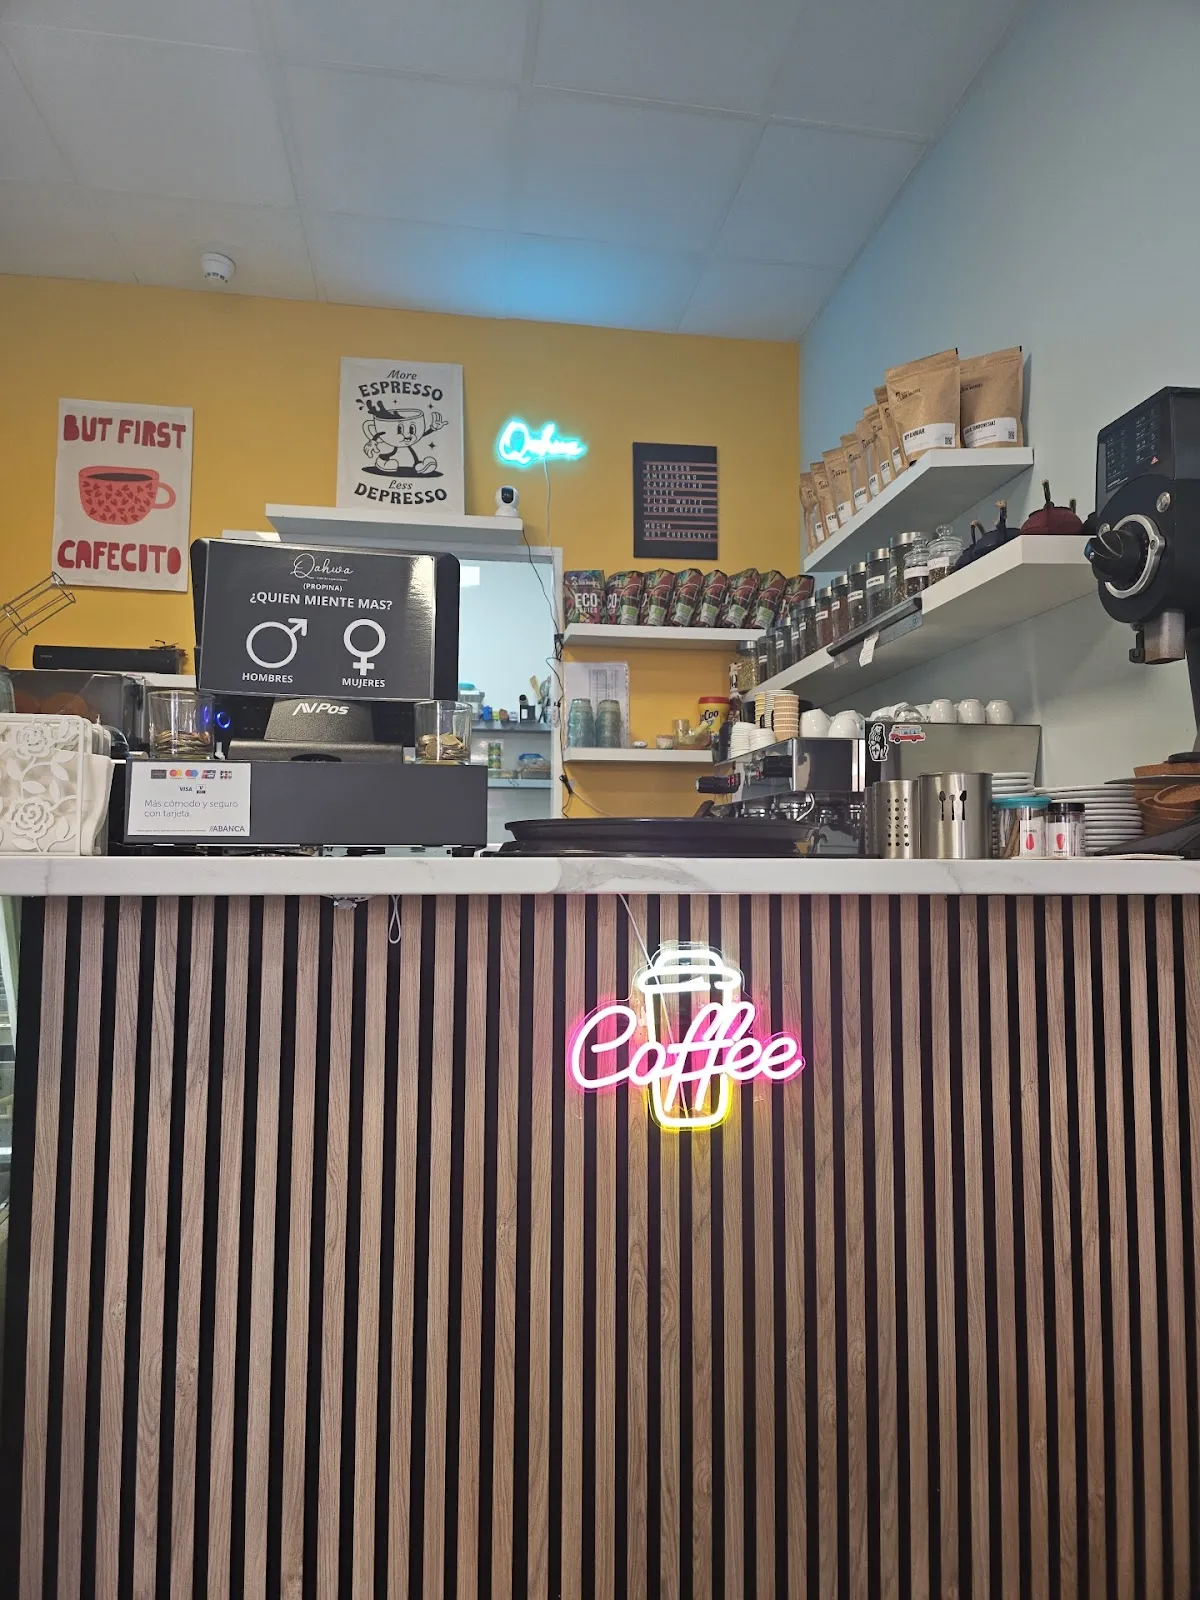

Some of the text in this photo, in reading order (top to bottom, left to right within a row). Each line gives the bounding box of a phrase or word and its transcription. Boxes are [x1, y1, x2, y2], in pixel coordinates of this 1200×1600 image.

[387, 369, 418, 380] More
[358, 381, 443, 401] ESPRESSO
[63, 414, 187, 449] BUT FIRST
[646, 464, 690, 472] ESPRESSO
[388, 480, 413, 490] Less
[646, 481, 703, 489] CAPPUCCINO
[354, 482, 447, 505] DEPRESSO
[647, 489, 675, 497] LATTE
[666, 531, 712, 539] CHOCOLATE
[57, 539, 182, 575] CAFECITO
[290, 553, 354, 579] Qahwa
[303, 582, 343, 592] (PROPINA)
[249, 591, 393, 610] ¿QUIEN MIENTE MAS?
[575, 592, 598, 608] ECO
[242, 672, 294, 684] HOMBRES
[342, 677, 386, 688] MUJERES
[144, 799, 239, 809] Más cómodo y seguro
[163, 809, 190, 819] tarjeta
[571, 1001, 803, 1112] Coffee
